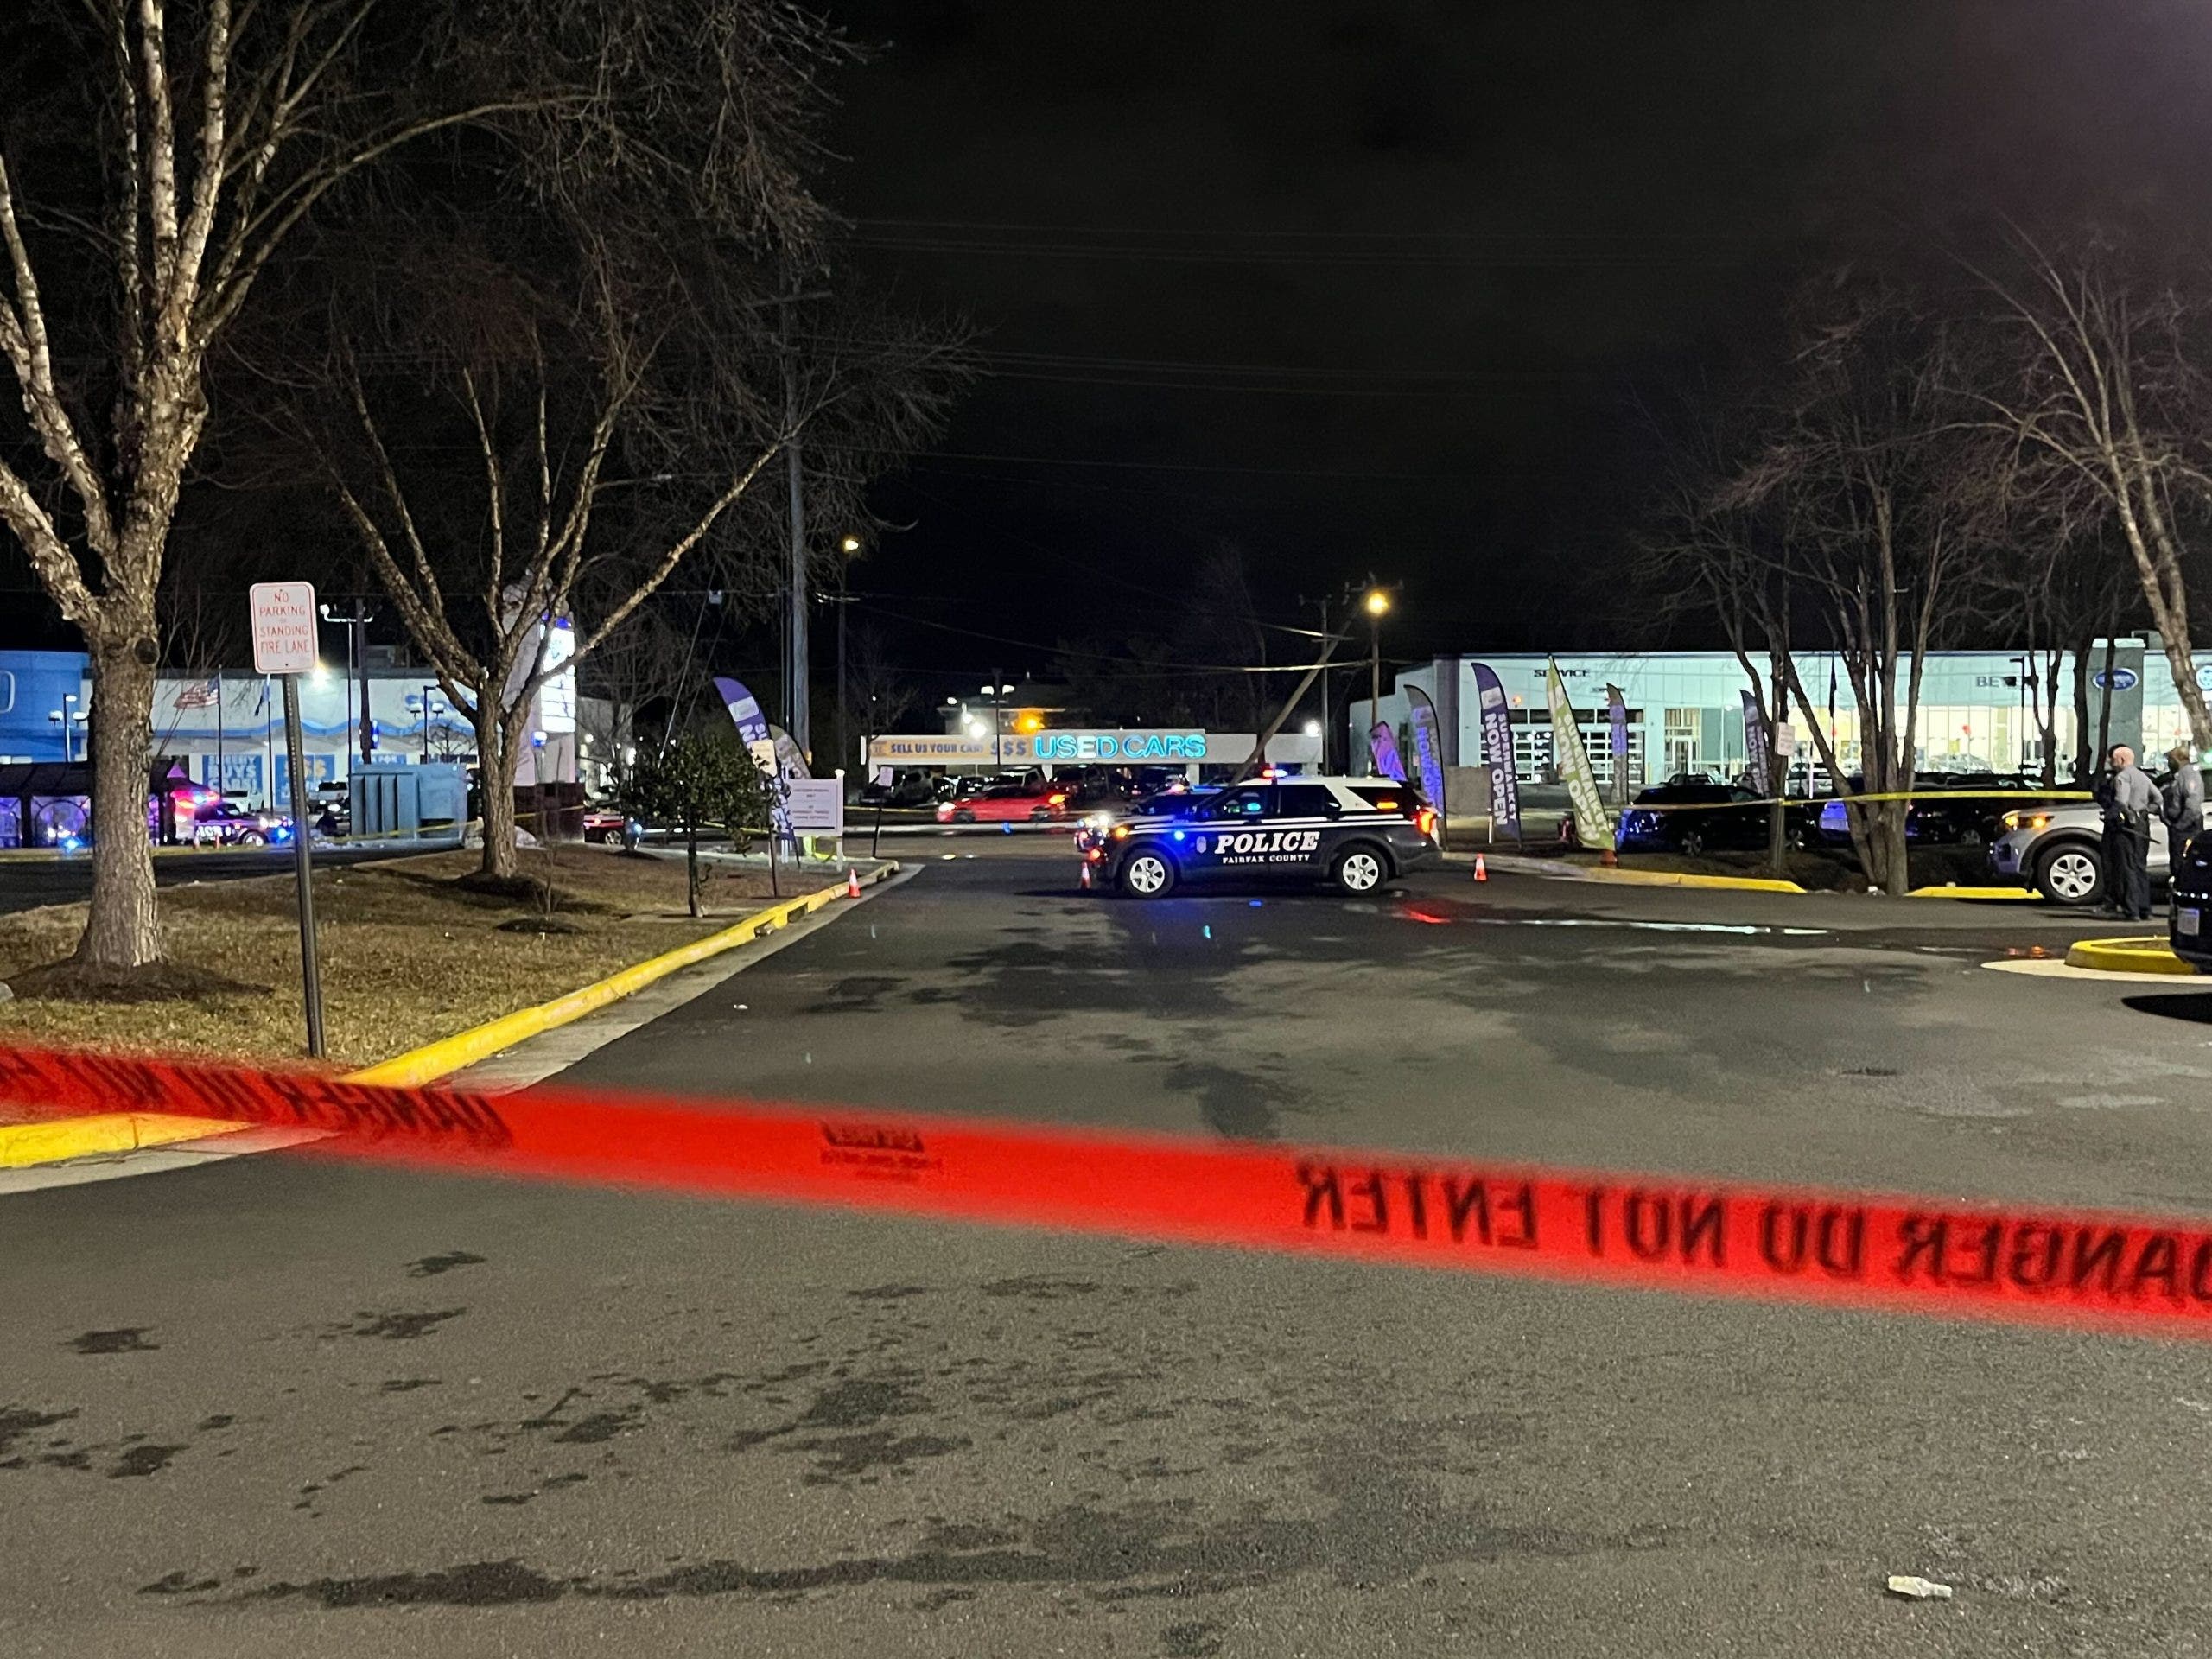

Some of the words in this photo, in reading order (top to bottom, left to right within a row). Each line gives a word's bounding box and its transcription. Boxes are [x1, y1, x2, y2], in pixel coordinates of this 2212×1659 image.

[274, 592, 289, 602] NO
[259, 606, 305, 616] PARKING
[260, 626, 308, 637] STANDING
[261, 640, 281, 654] FIRE
[285, 639, 309, 654] LANE
[1534, 669, 1590, 677] SVICE
[1484, 713, 1503, 764] NOW
[891, 743, 913, 753] SELL
[915, 743, 928, 753] US
[930, 743, 957, 753] YOUR
[1033, 734, 1118, 759] USED
[1123, 734, 1206, 759] CARS
[1497, 713, 1517, 820] SUPERMARKET
[1491, 768, 1508, 825] OPEN
[1214, 831, 1320, 854] POLICE
[1223, 855, 1265, 864] FAIRFAX
[1269, 854, 1311, 862] COUNTY
